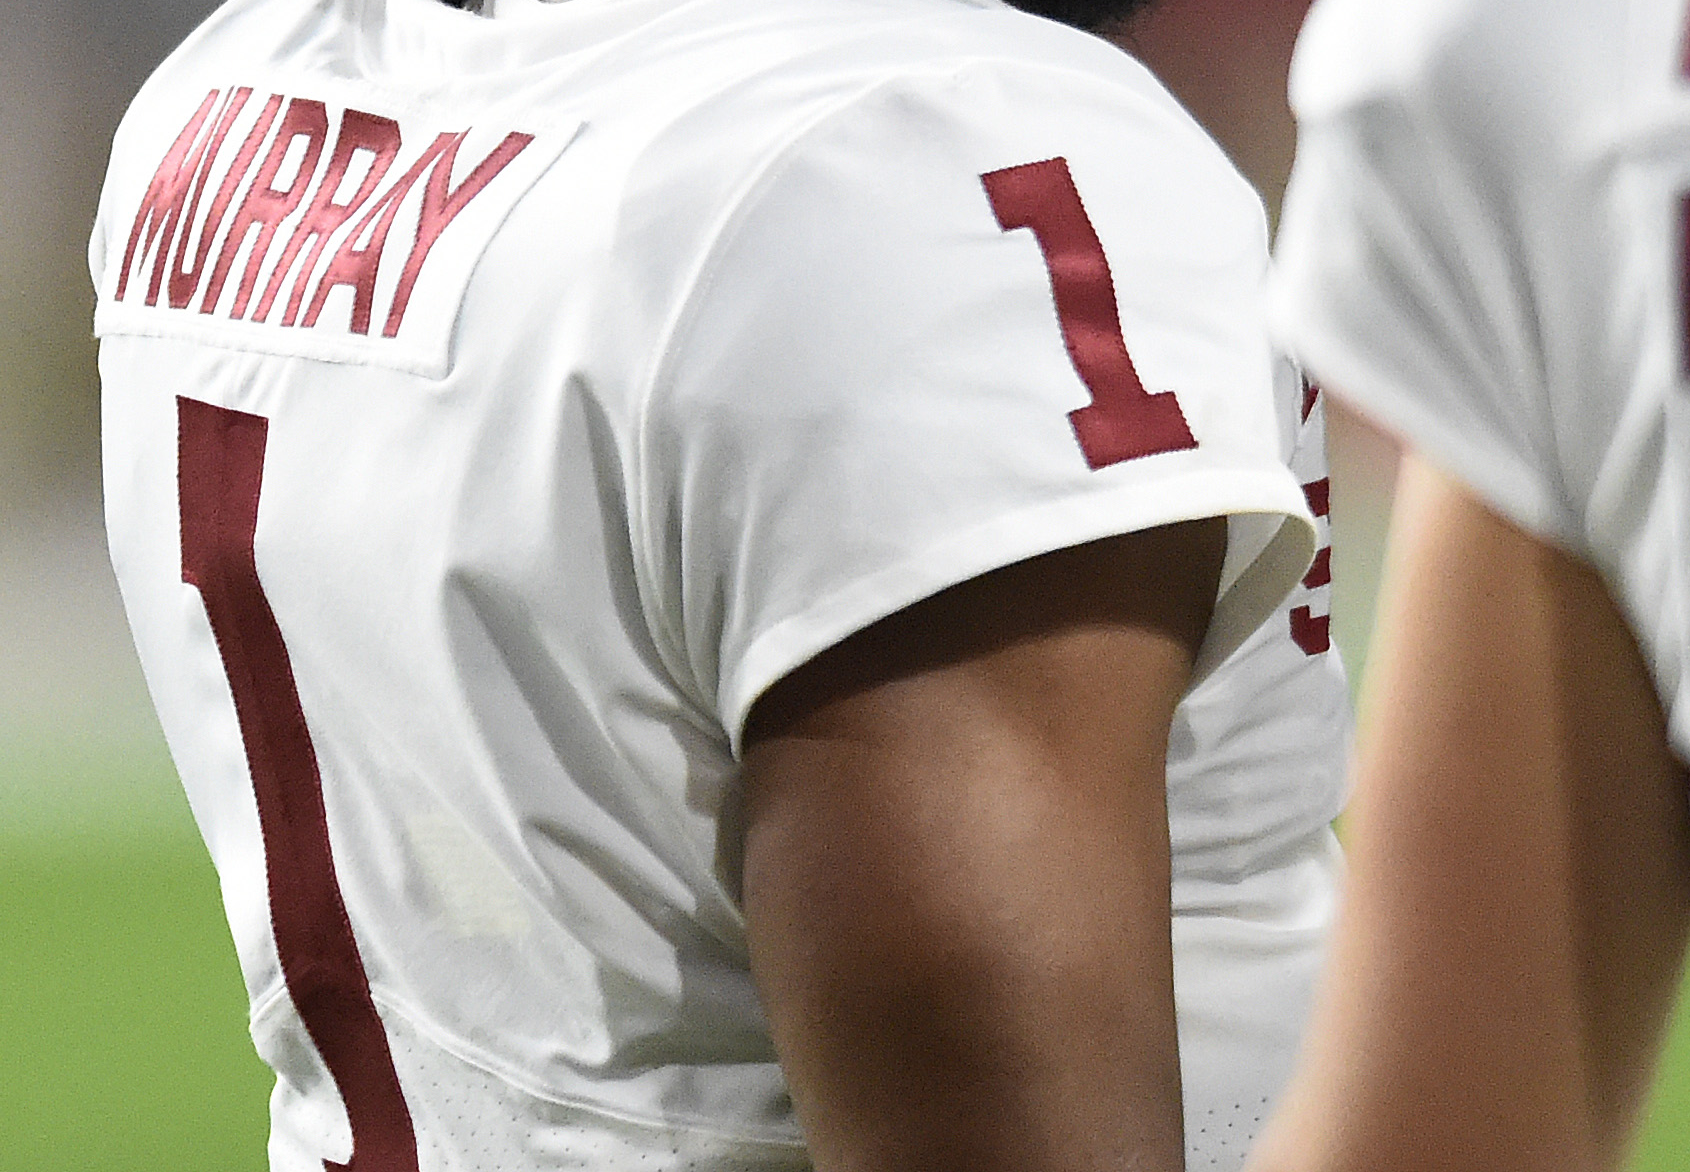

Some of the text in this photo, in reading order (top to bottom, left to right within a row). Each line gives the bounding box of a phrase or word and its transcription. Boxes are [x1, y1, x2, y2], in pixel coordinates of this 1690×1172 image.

[114, 85, 535, 339] MURRAY
[980, 156, 1199, 471] 1
[176, 394, 419, 1172] 1
